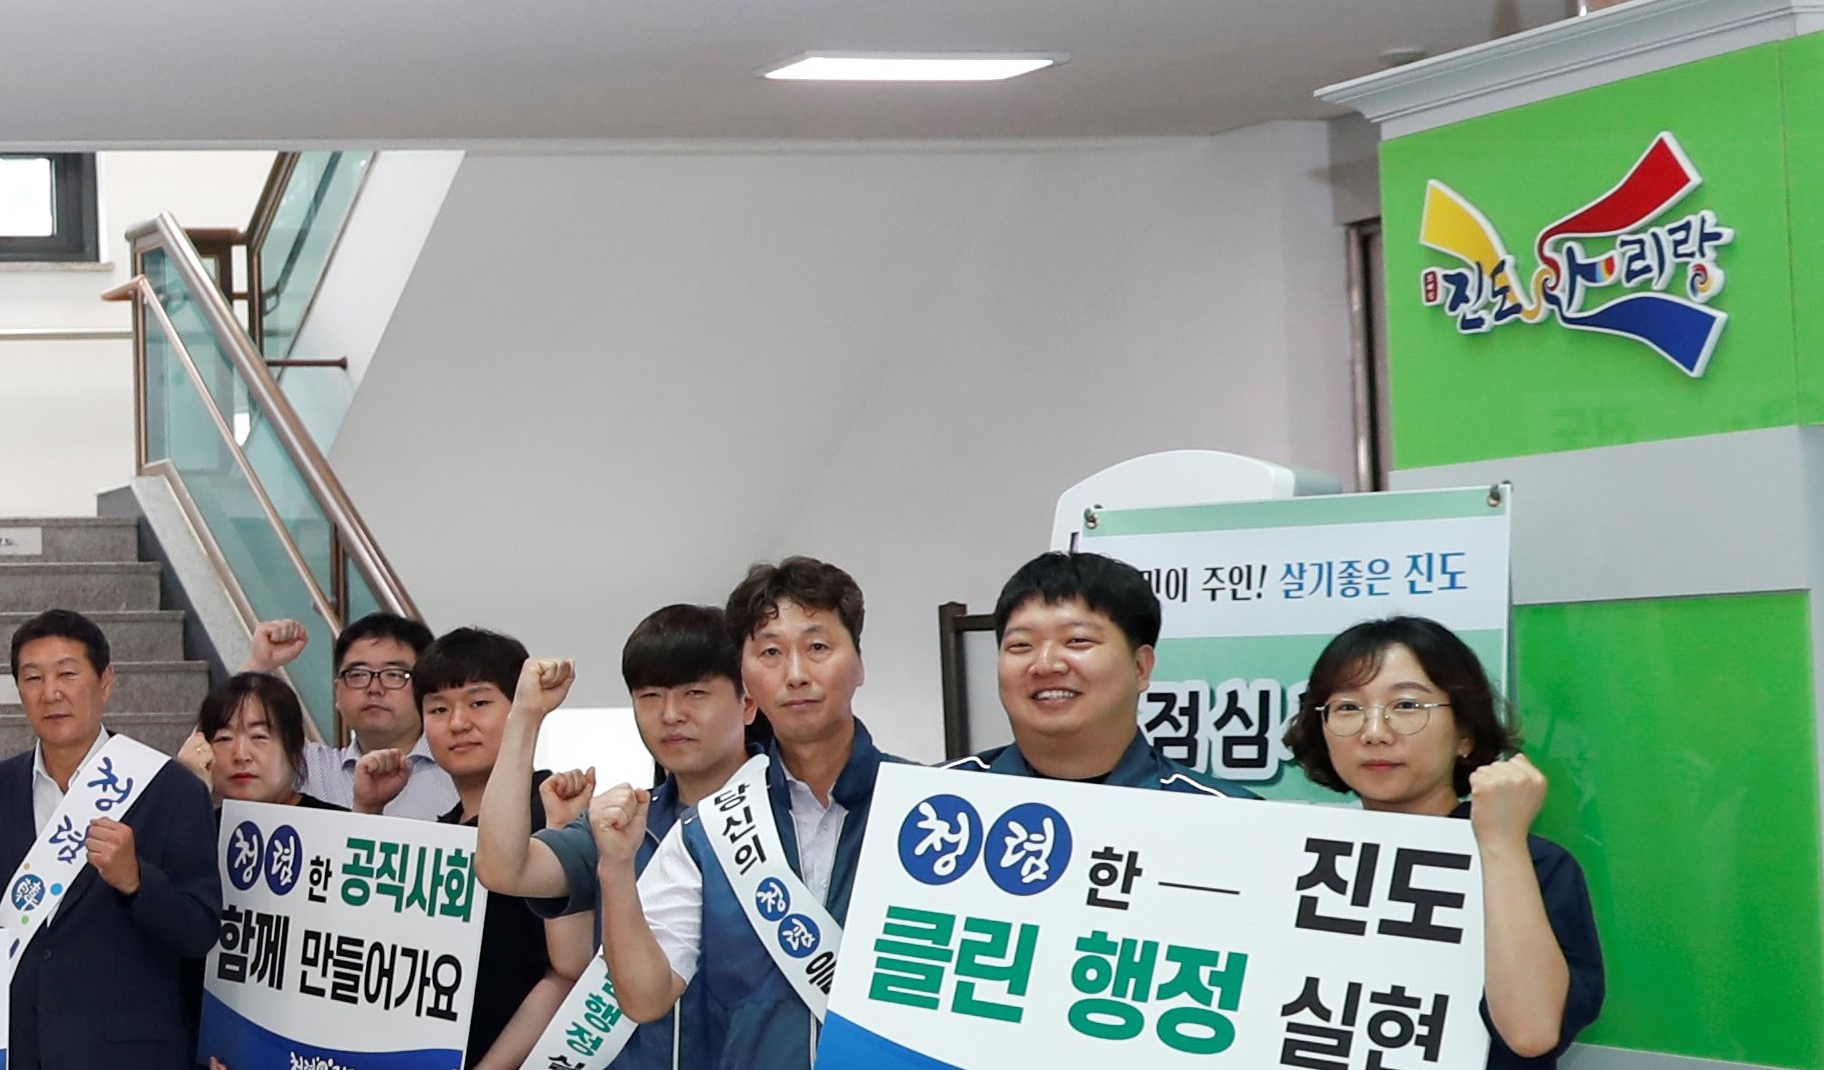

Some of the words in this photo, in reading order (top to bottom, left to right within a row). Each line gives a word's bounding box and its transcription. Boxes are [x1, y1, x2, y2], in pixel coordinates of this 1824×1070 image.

[1201, 564, 1268, 602] 주인!
[1279, 557, 1393, 600] 살기좋은
[1405, 552, 1468, 595] 진도
[1145, 688, 1272, 770] 점심
[713, 782, 769, 876] 당신의
[340, 837, 476, 923] 공직사회
[1294, 836, 1472, 945] 진도
[217, 904, 290, 991] 함께
[299, 929, 463, 1022] 만들어가요
[868, 905, 1041, 1024] 클린
[1067, 930, 1249, 1055] 행정
